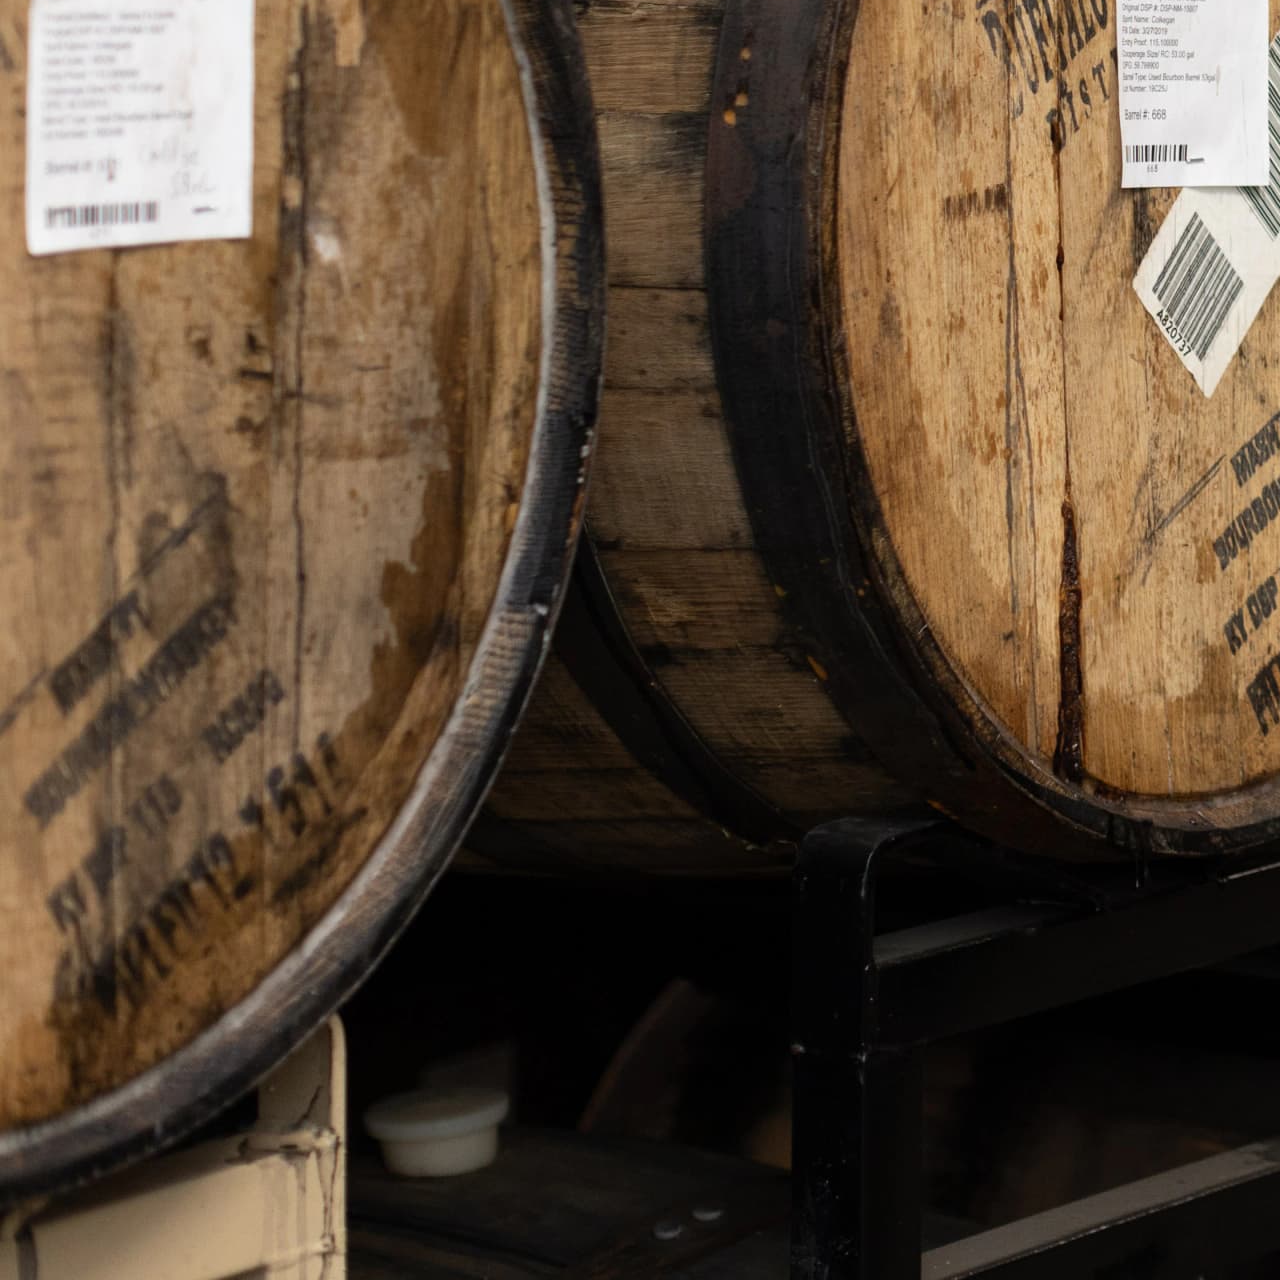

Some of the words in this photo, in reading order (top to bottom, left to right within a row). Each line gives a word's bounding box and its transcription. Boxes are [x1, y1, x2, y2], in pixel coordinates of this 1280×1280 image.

[1124, 109, 1141, 120] Barrel
[1151, 108, 1167, 120] 668
[1156, 309, 1192, 357] A820737
